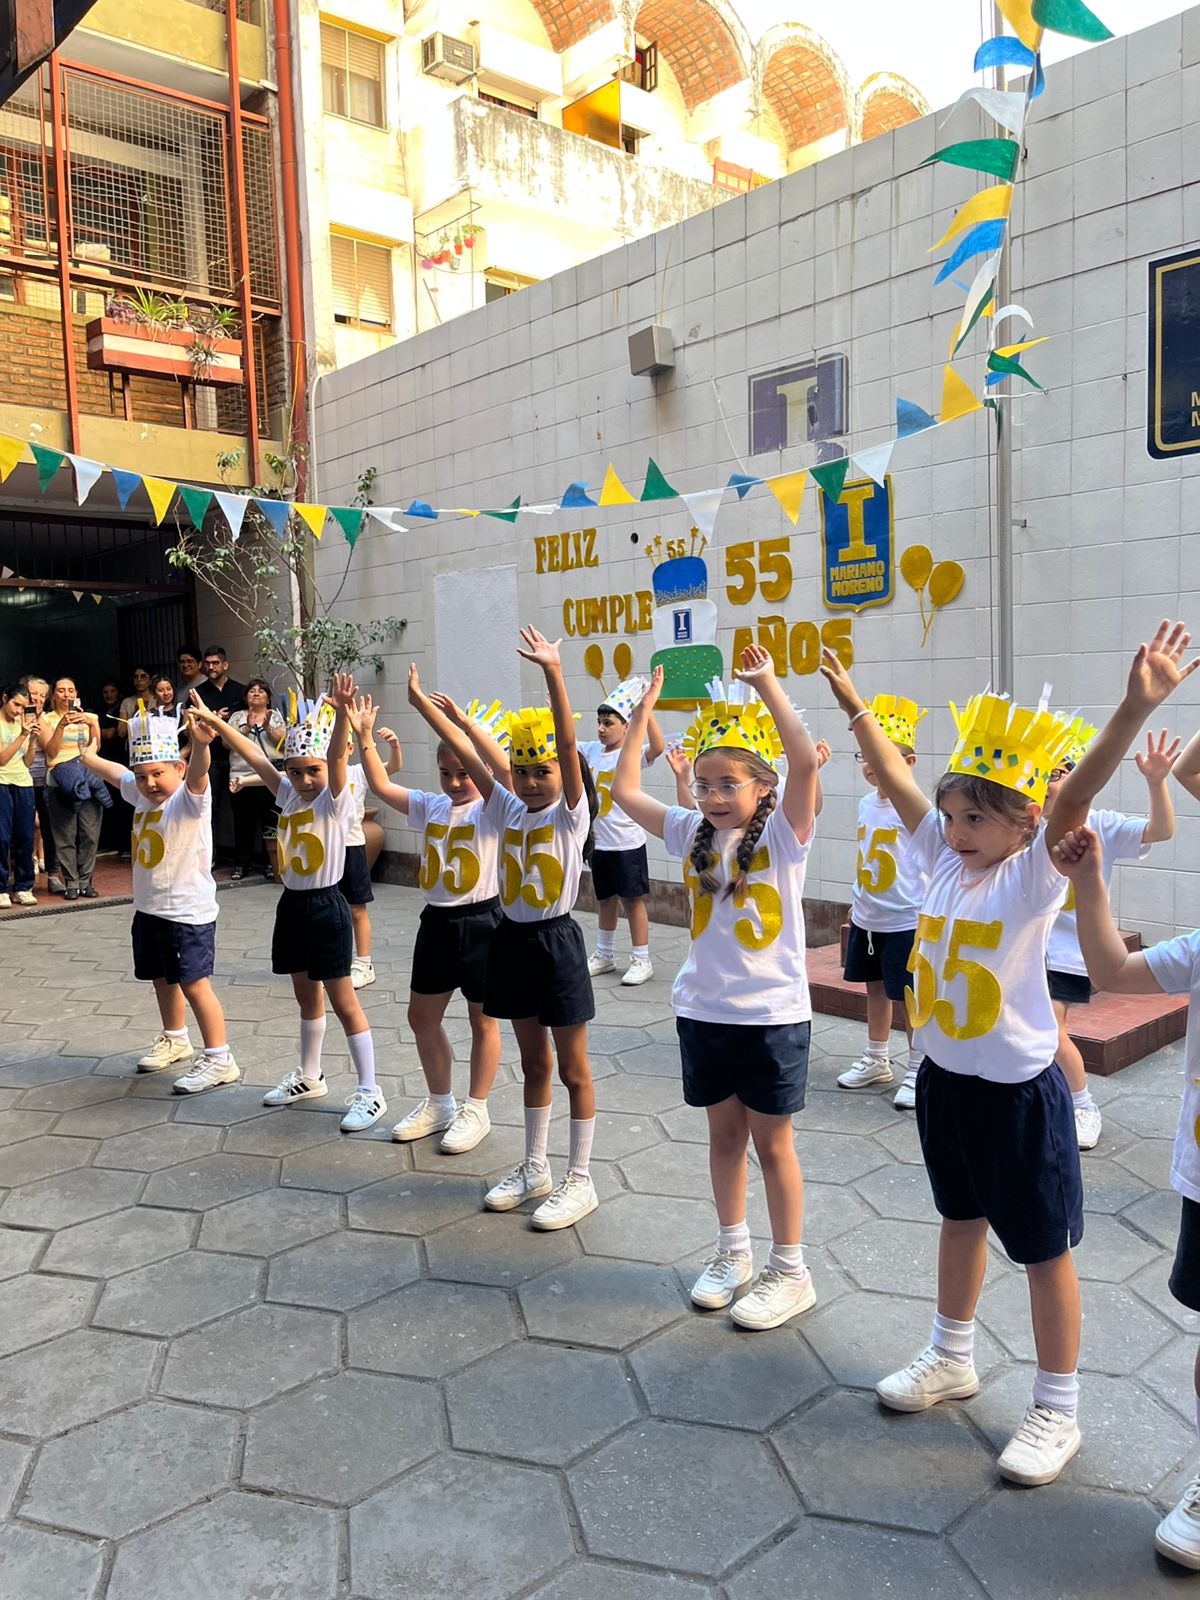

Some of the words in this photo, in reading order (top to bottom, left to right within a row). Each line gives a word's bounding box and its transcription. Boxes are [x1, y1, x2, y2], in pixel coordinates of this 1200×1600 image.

[534, 528, 599, 574] FELIZ
[666, 538, 686, 560] 55
[726, 536, 792, 606] 55
[830, 560, 885, 582] MARIANO
[831, 576, 884, 597] MORENO
[563, 591, 652, 637] CUMPLE
[419, 822, 480, 895] 55
[904, 913, 1003, 1041] 55
